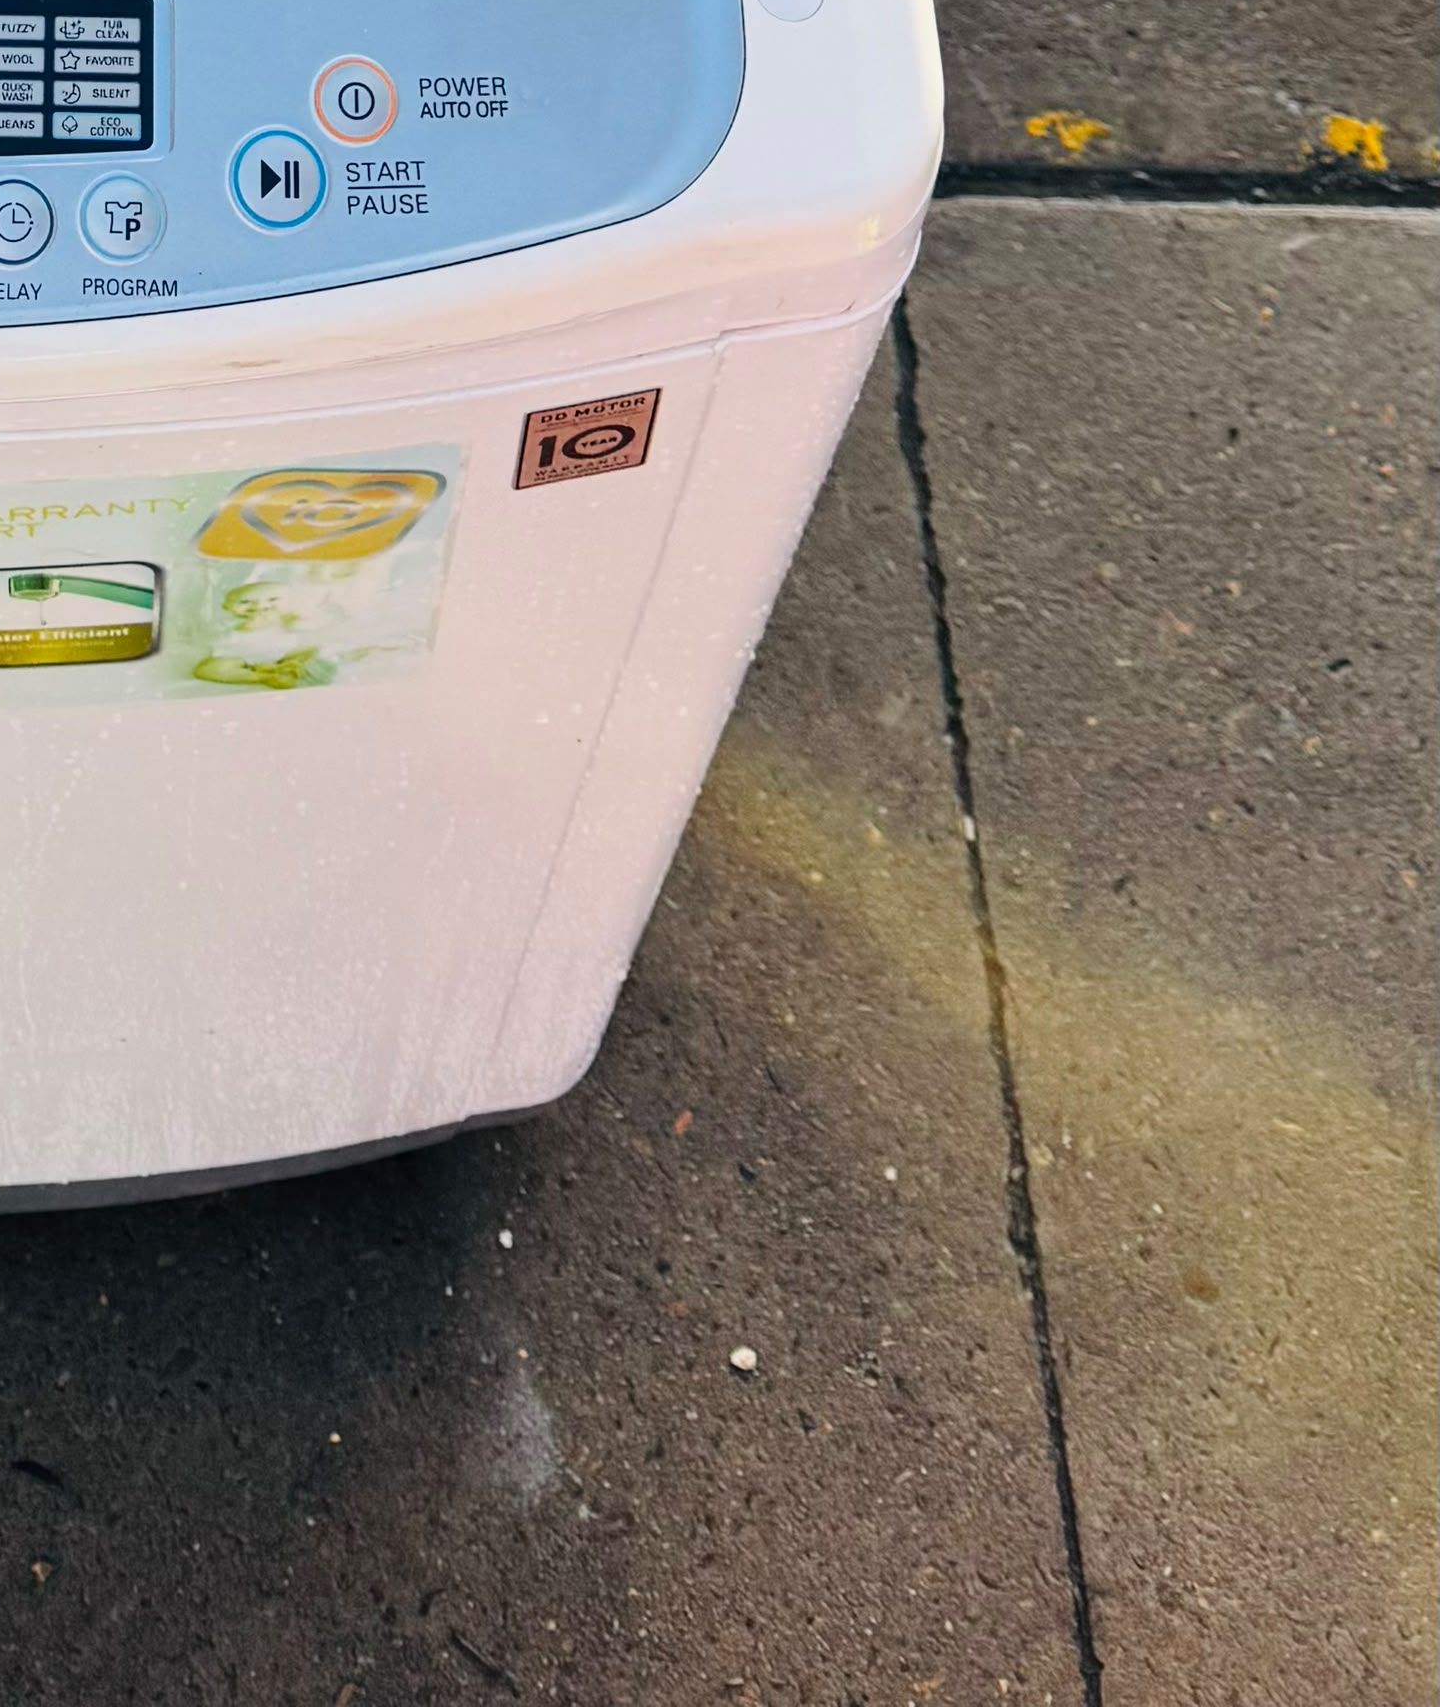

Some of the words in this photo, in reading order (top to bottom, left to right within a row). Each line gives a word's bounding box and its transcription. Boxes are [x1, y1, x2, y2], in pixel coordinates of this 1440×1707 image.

[103, 20, 123, 28] TUB
[95, 29, 129, 39] CLEAN
[1, 54, 35, 65] WOOL
[85, 55, 135, 67] FAVORITE
[1, 82, 34, 92] QUICK
[92, 88, 131, 98] SILENT
[418, 76, 507, 98] POWER
[1, 92, 33, 102] WASH
[420, 101, 471, 119] AUTO
[475, 100, 510, 118] OFF
[100, 116, 121, 126] ECO
[89, 127, 133, 137] COTTON
[346, 160, 426, 184] START
[347, 193, 430, 216] PAUSE
[82, 278, 179, 298] PROGRAM
[540, 412, 568, 424] DD
[574, 397, 646, 418] MOTOR
[538, 424, 636, 468] 10
[580, 436, 618, 449] YEAR
[39, 626, 130, 642] Efficient
